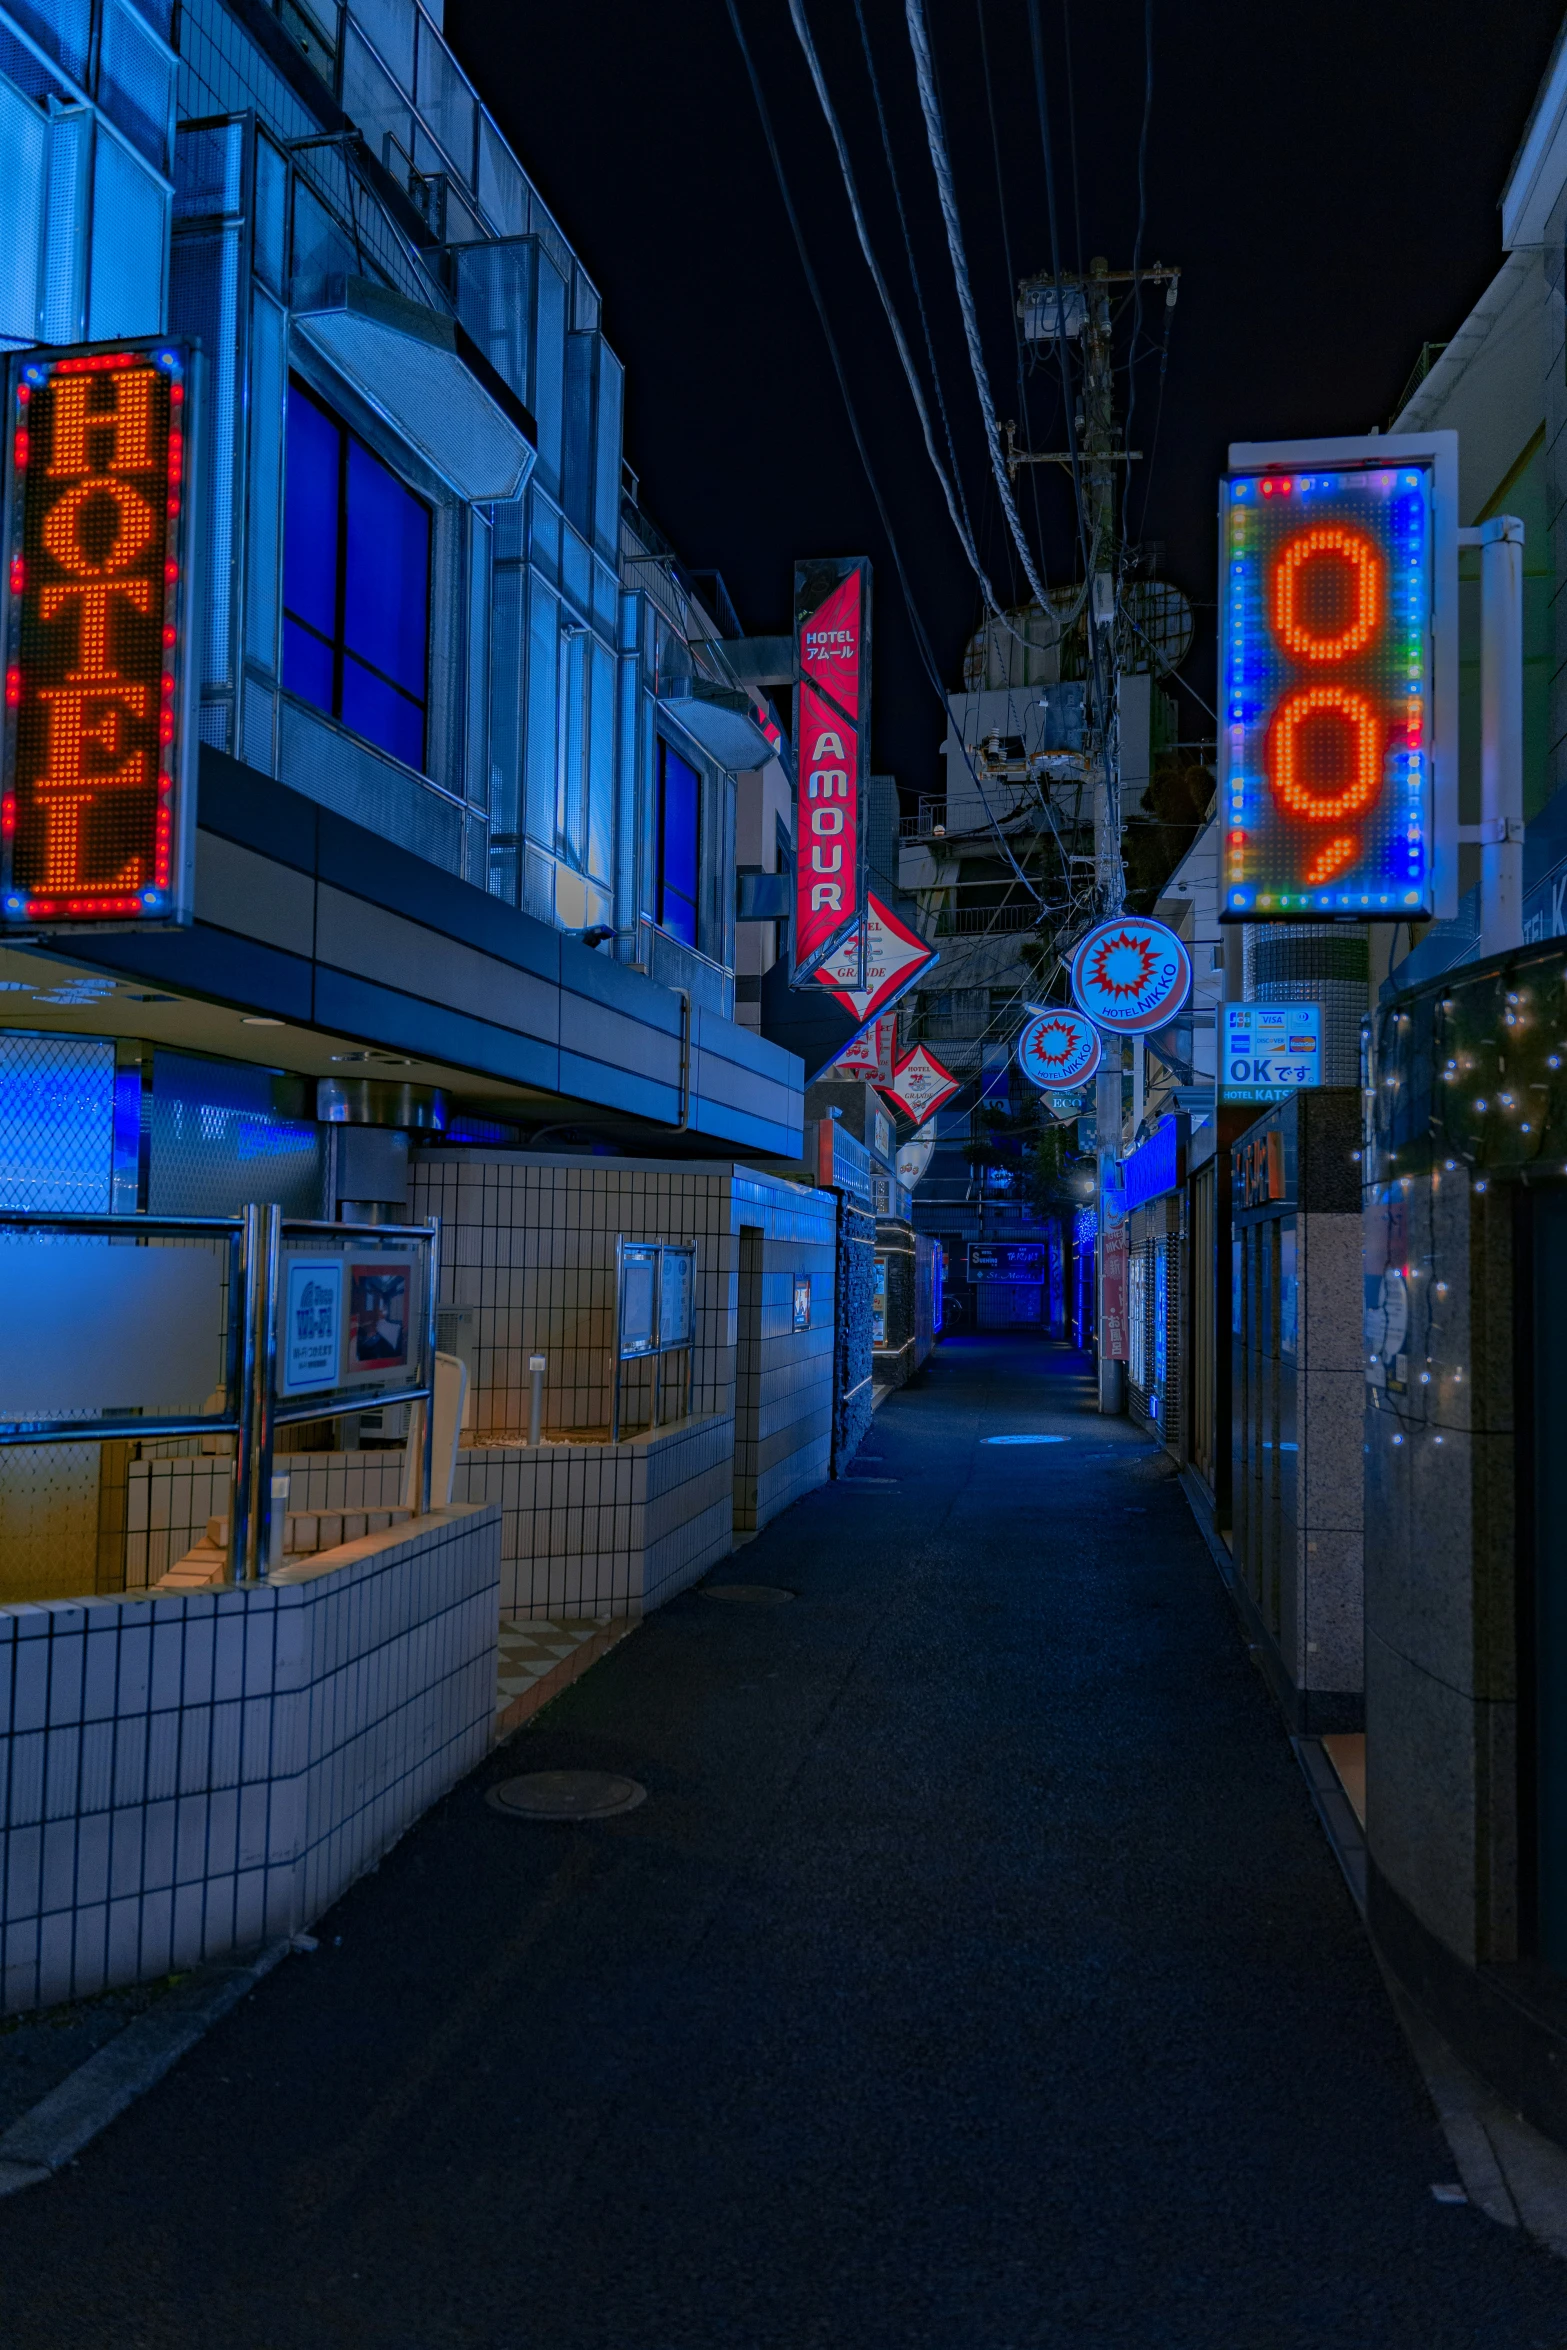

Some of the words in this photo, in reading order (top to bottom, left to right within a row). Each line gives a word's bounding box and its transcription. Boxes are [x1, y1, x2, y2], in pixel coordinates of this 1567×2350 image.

[31, 367, 155, 893] HOTEL
[806, 630, 855, 645] HOTEL
[806, 647, 854, 661] アムール
[808, 731, 848, 912] AMOUR
[1101, 1006, 1140, 1018] HOTEL
[1136, 963, 1177, 1013] NIKKO
[1262, 1016, 1283, 1024] VISA
[1037, 1069, 1064, 1079] HOTEL
[1062, 1043, 1092, 1077] NIKKO
[1223, 1091, 1253, 1099] HOTEL
[1255, 1089, 1293, 1101] KATS
